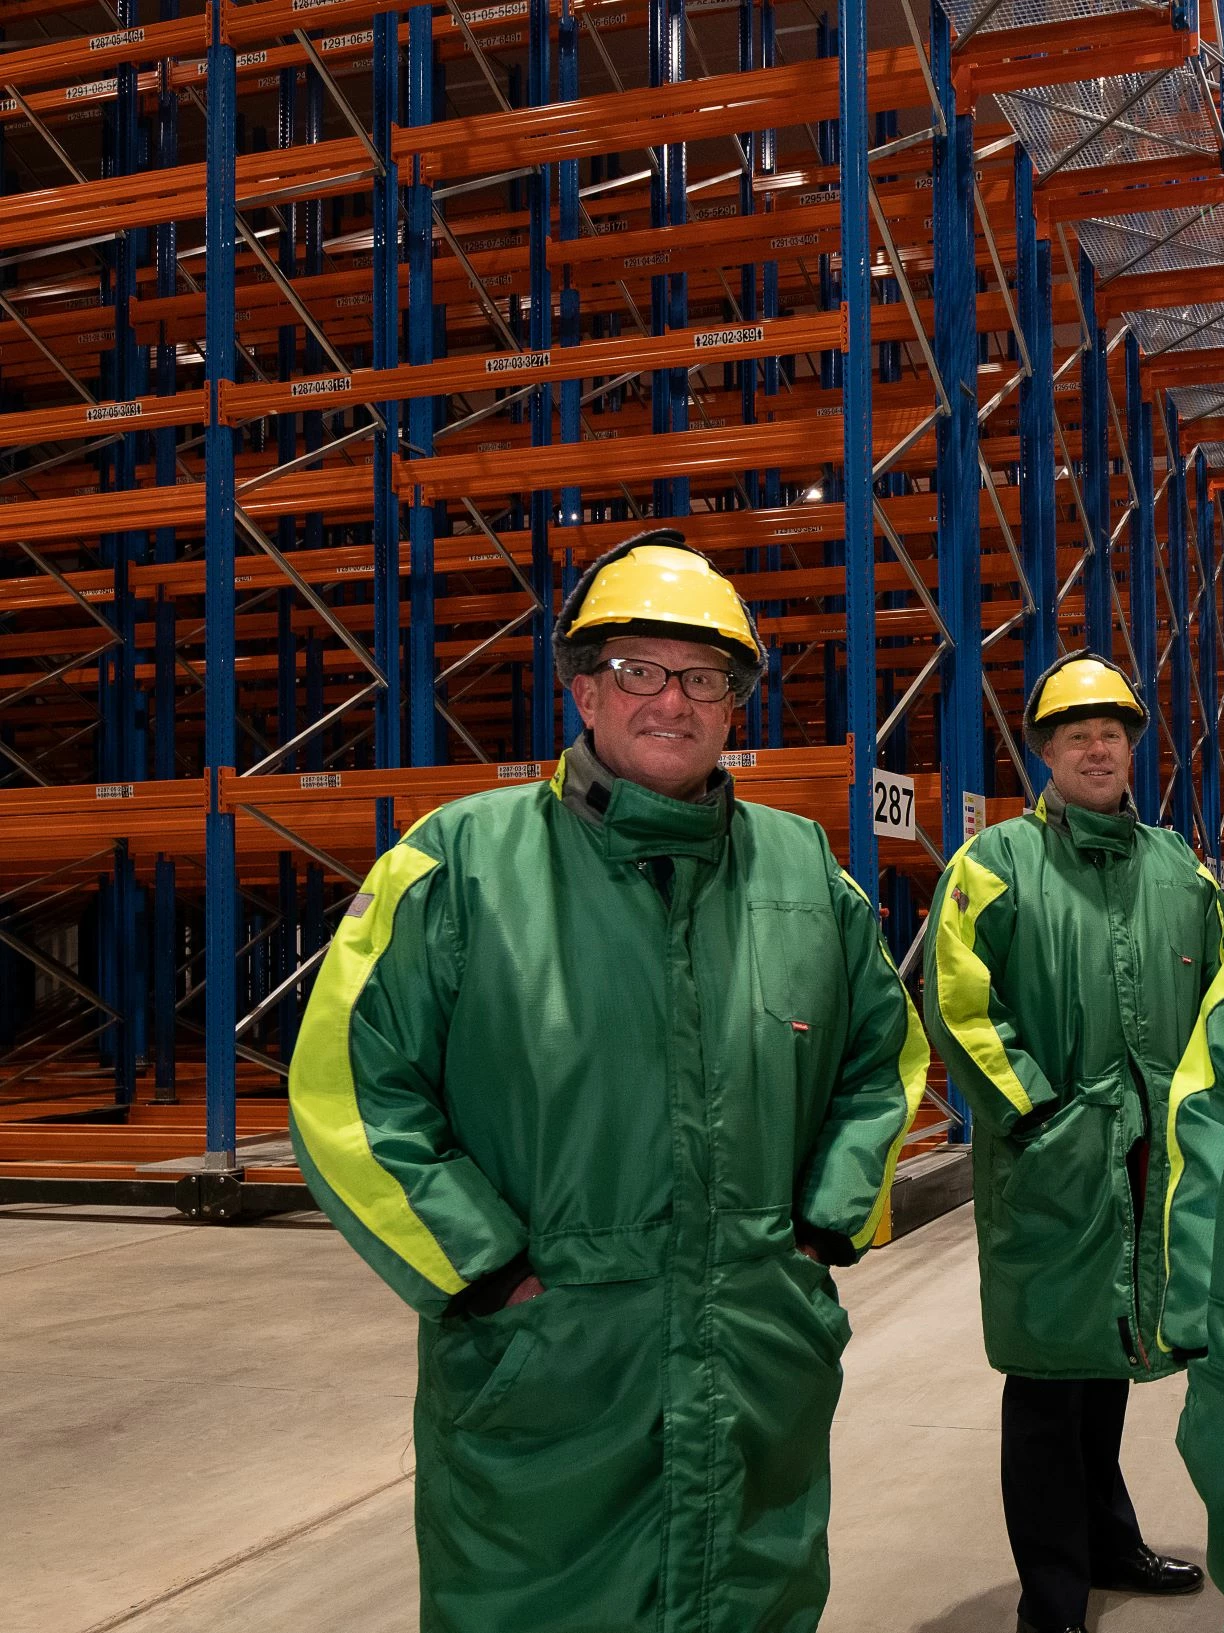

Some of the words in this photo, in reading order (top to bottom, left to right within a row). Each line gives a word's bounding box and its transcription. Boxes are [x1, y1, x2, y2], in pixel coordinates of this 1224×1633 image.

[462, 2, 522, 23] 91·05·559
[328, 32, 372, 49] 291·06·5
[805, 192, 839, 204] 295·04·
[875, 781, 913, 827] 287
